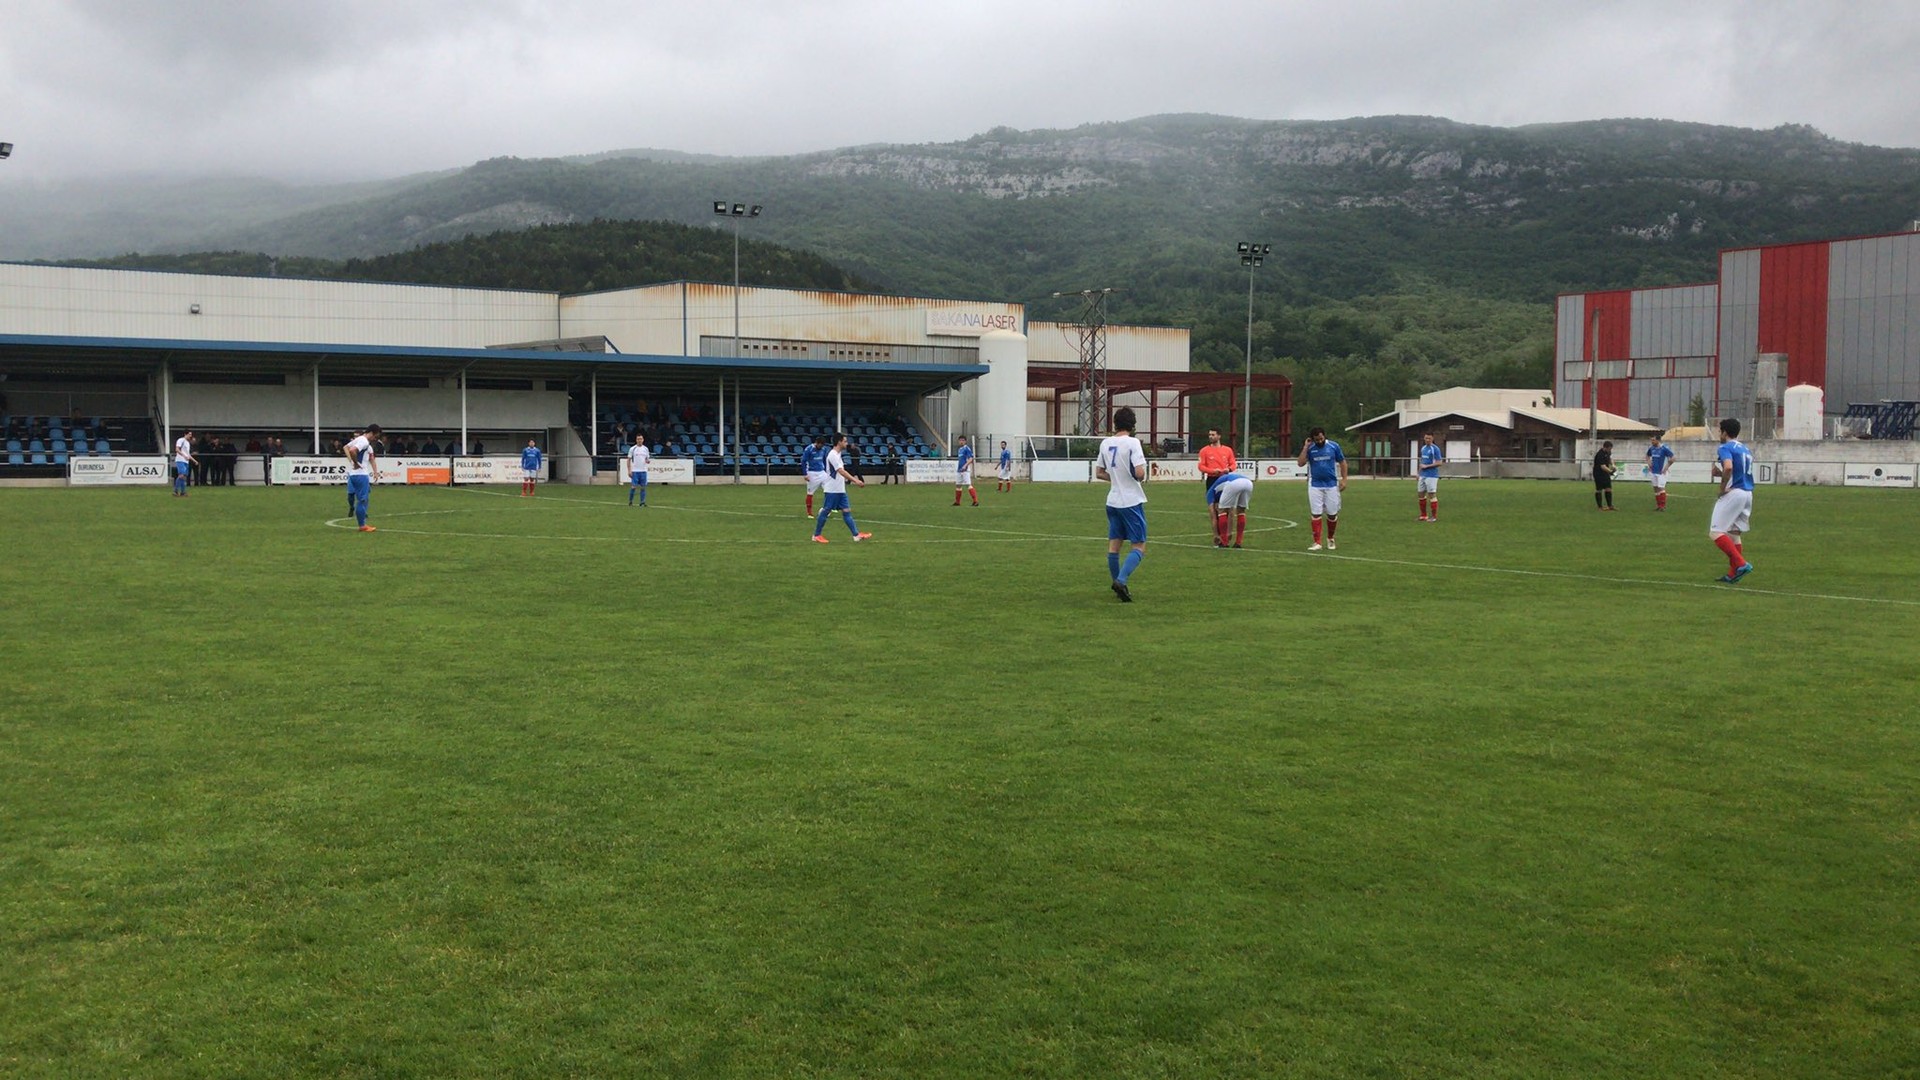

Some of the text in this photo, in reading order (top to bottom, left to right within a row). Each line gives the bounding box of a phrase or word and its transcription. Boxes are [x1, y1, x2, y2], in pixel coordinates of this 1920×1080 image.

[1108, 446, 1118, 467] 7
[126, 467, 158, 476] ALSA
[292, 465, 346, 474] ACEDES
